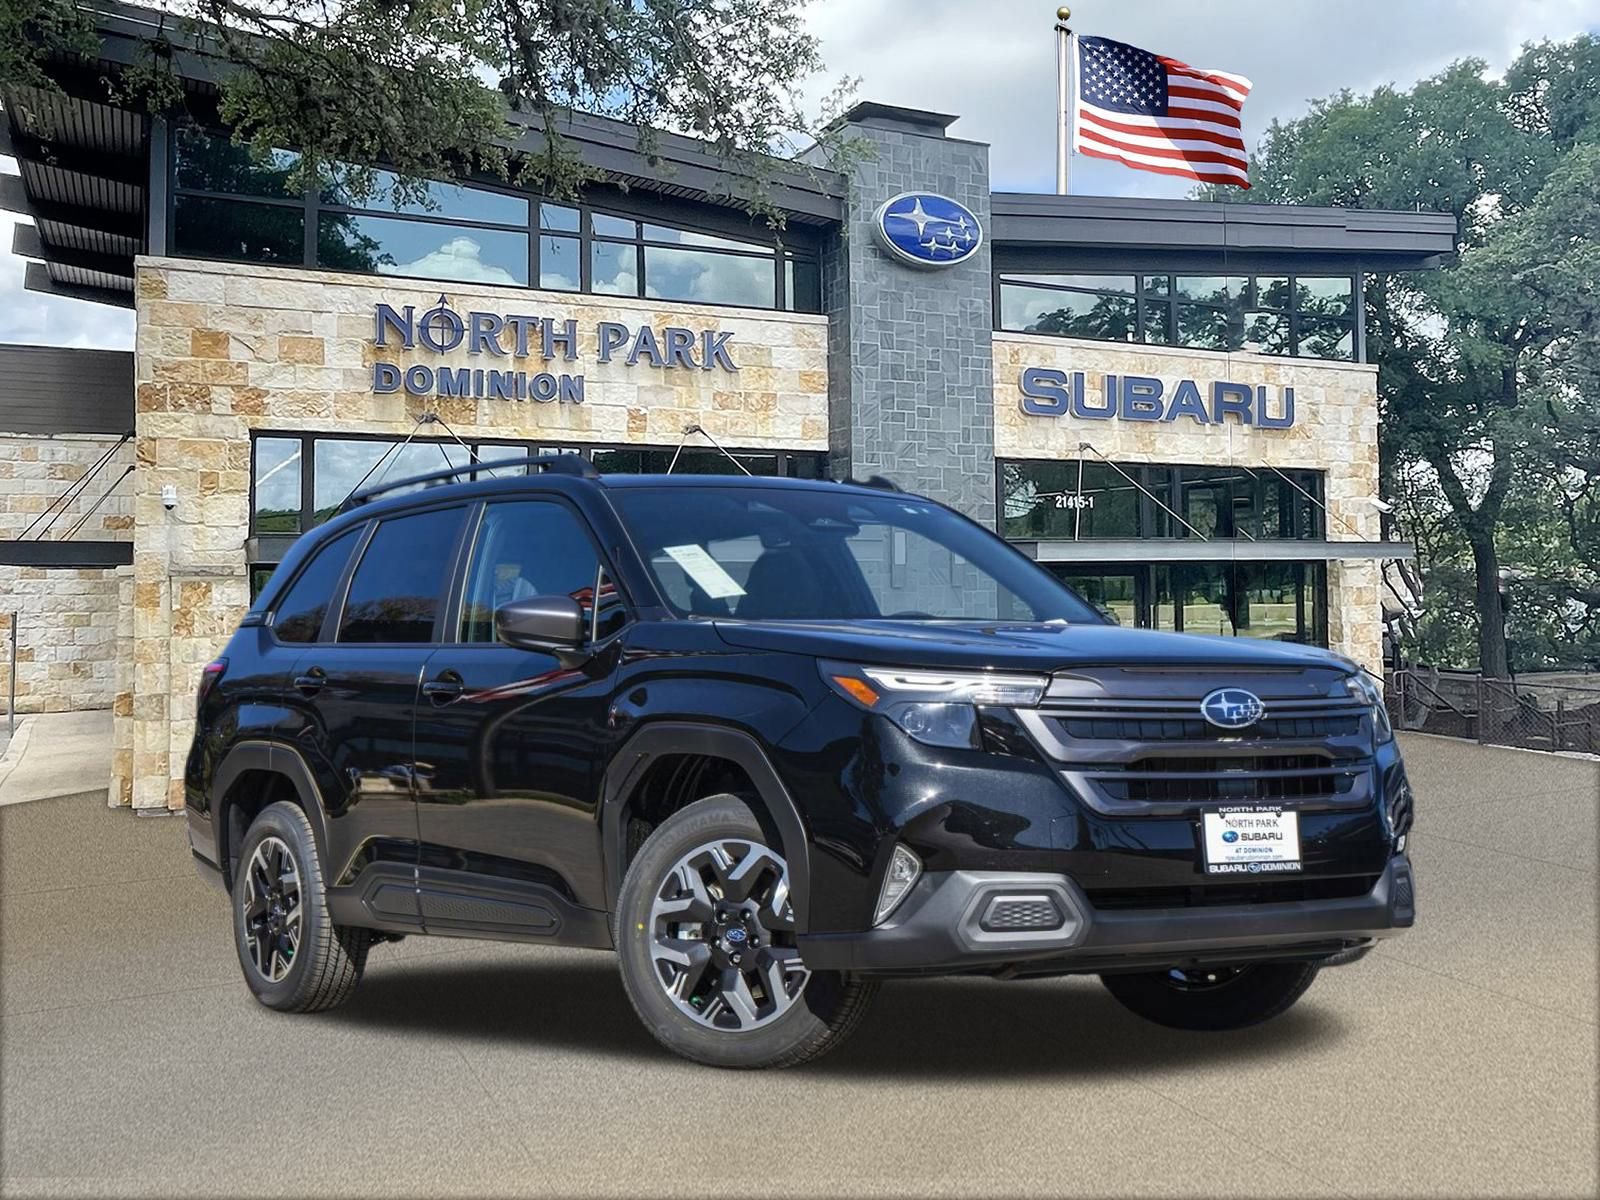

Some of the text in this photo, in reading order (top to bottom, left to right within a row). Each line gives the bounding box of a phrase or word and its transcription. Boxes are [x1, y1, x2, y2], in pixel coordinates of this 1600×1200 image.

[375, 300, 741, 373] NORTH PARK
[373, 362, 585, 404] DOMINION
[1018, 367, 1295, 429] SUBARU
[1225, 818, 1280, 828] NORTH PARK
[1240, 832, 1283, 841] SUBARU
[1209, 862, 1301, 873] SUBARU DOMINION
